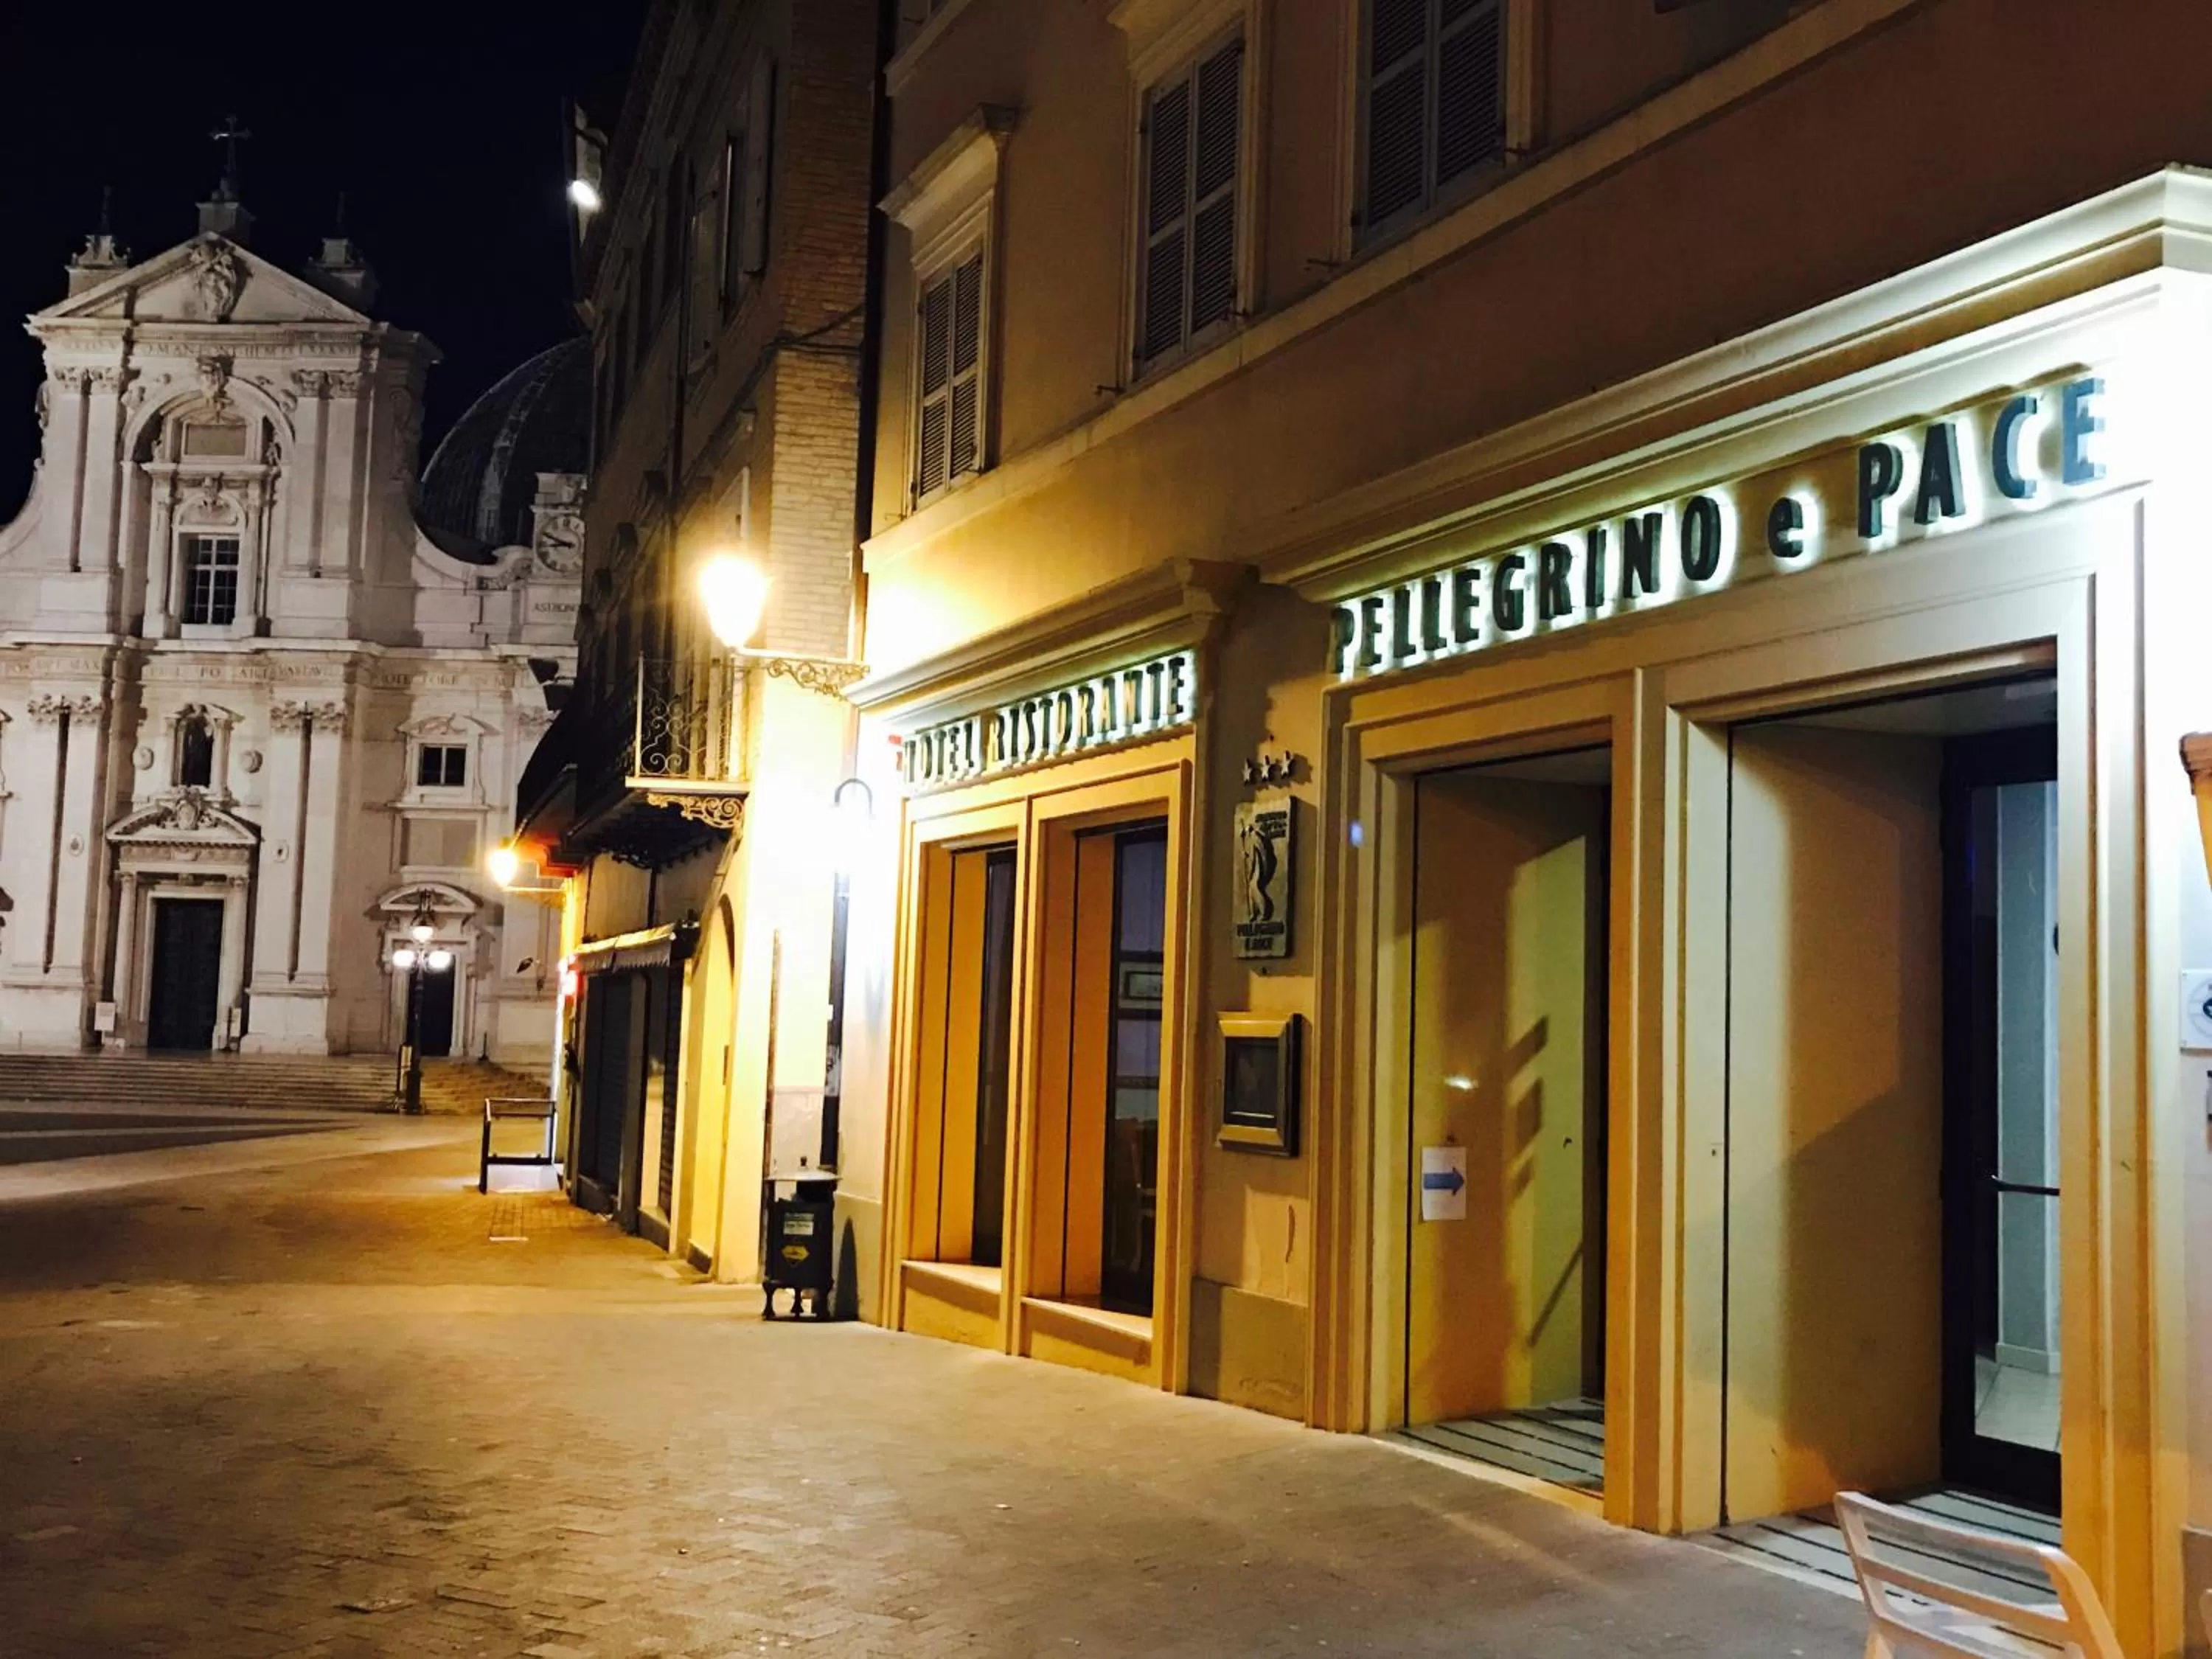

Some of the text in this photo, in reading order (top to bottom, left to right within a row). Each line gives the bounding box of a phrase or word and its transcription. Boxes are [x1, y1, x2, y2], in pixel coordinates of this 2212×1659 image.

[1329, 378, 2107, 674] PELLEGRINO e PACE
[902, 656, 1185, 785] HOTEL RISTORANTE
